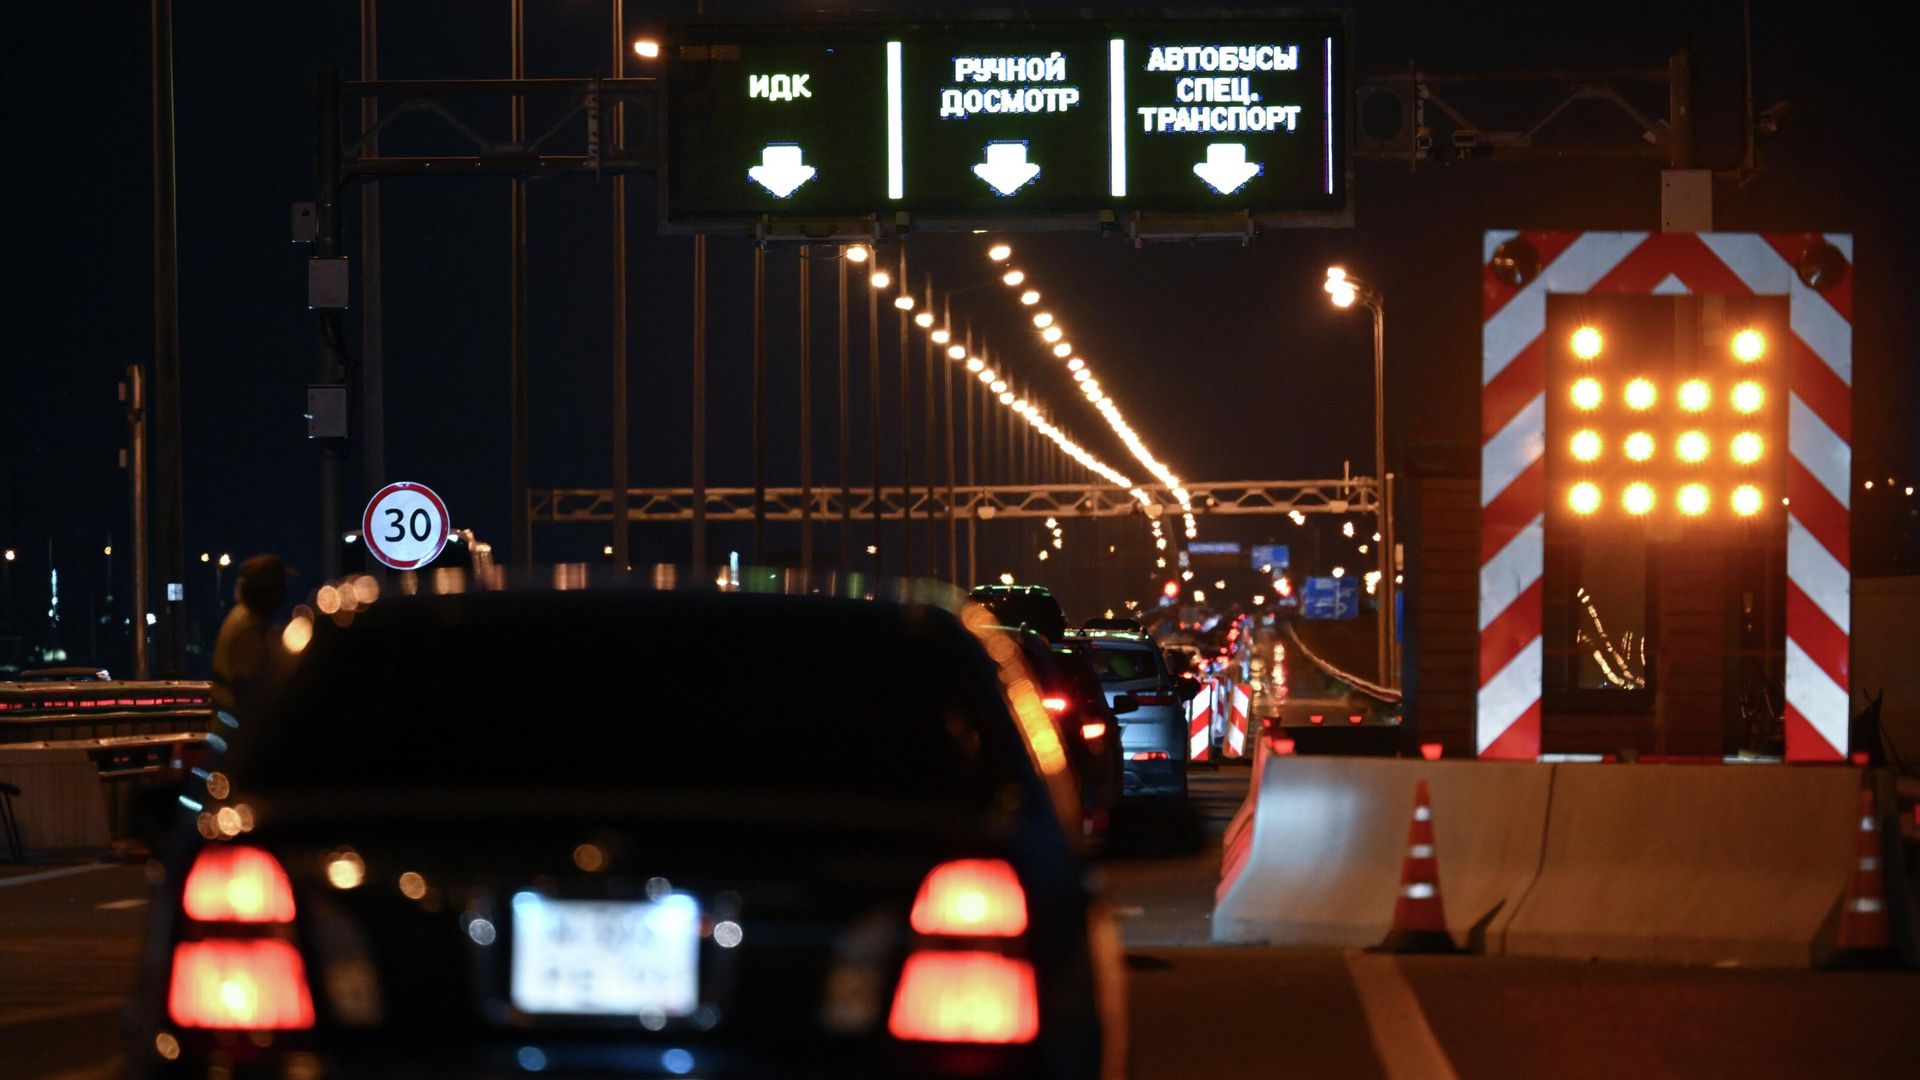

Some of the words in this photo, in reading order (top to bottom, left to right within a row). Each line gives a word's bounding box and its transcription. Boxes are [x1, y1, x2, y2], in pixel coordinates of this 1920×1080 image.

[954, 52, 1066, 82] РУЧНОЙ
[1147, 45, 1299, 72] АВТОБУСЫ
[749, 74, 812, 101] ИДК
[1176, 77, 1260, 106] СПЕЦ.
[940, 88, 1080, 117] ДОСМОТР
[1137, 105, 1301, 132] ТРАНСПОРТ
[384, 508, 432, 542] 30
